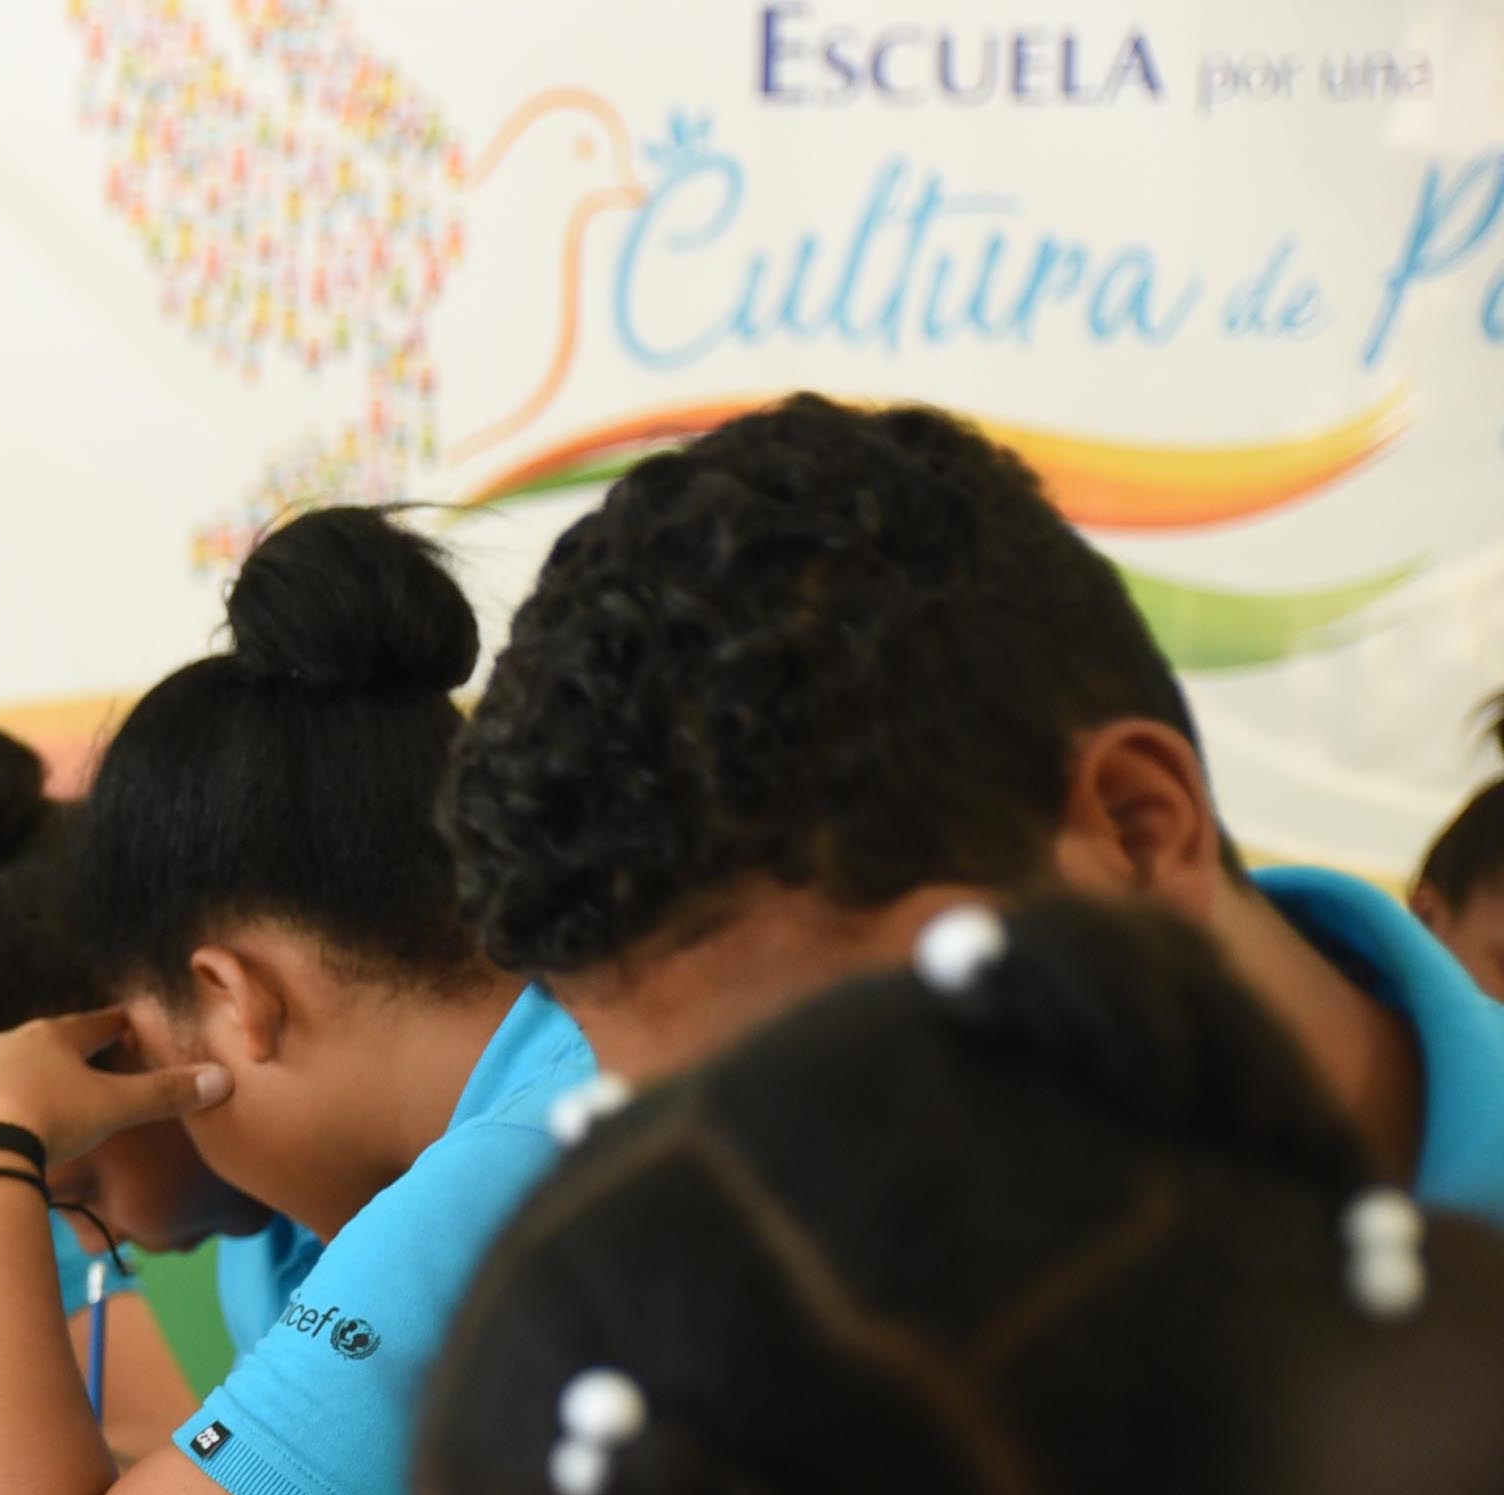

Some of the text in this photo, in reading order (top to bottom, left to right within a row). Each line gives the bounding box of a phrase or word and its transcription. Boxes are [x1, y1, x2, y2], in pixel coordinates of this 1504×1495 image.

[751, 1, 1434, 118] ESCUELA por una
[612, 140, 1206, 371] Cultura
[1220, 228, 1336, 342] de
